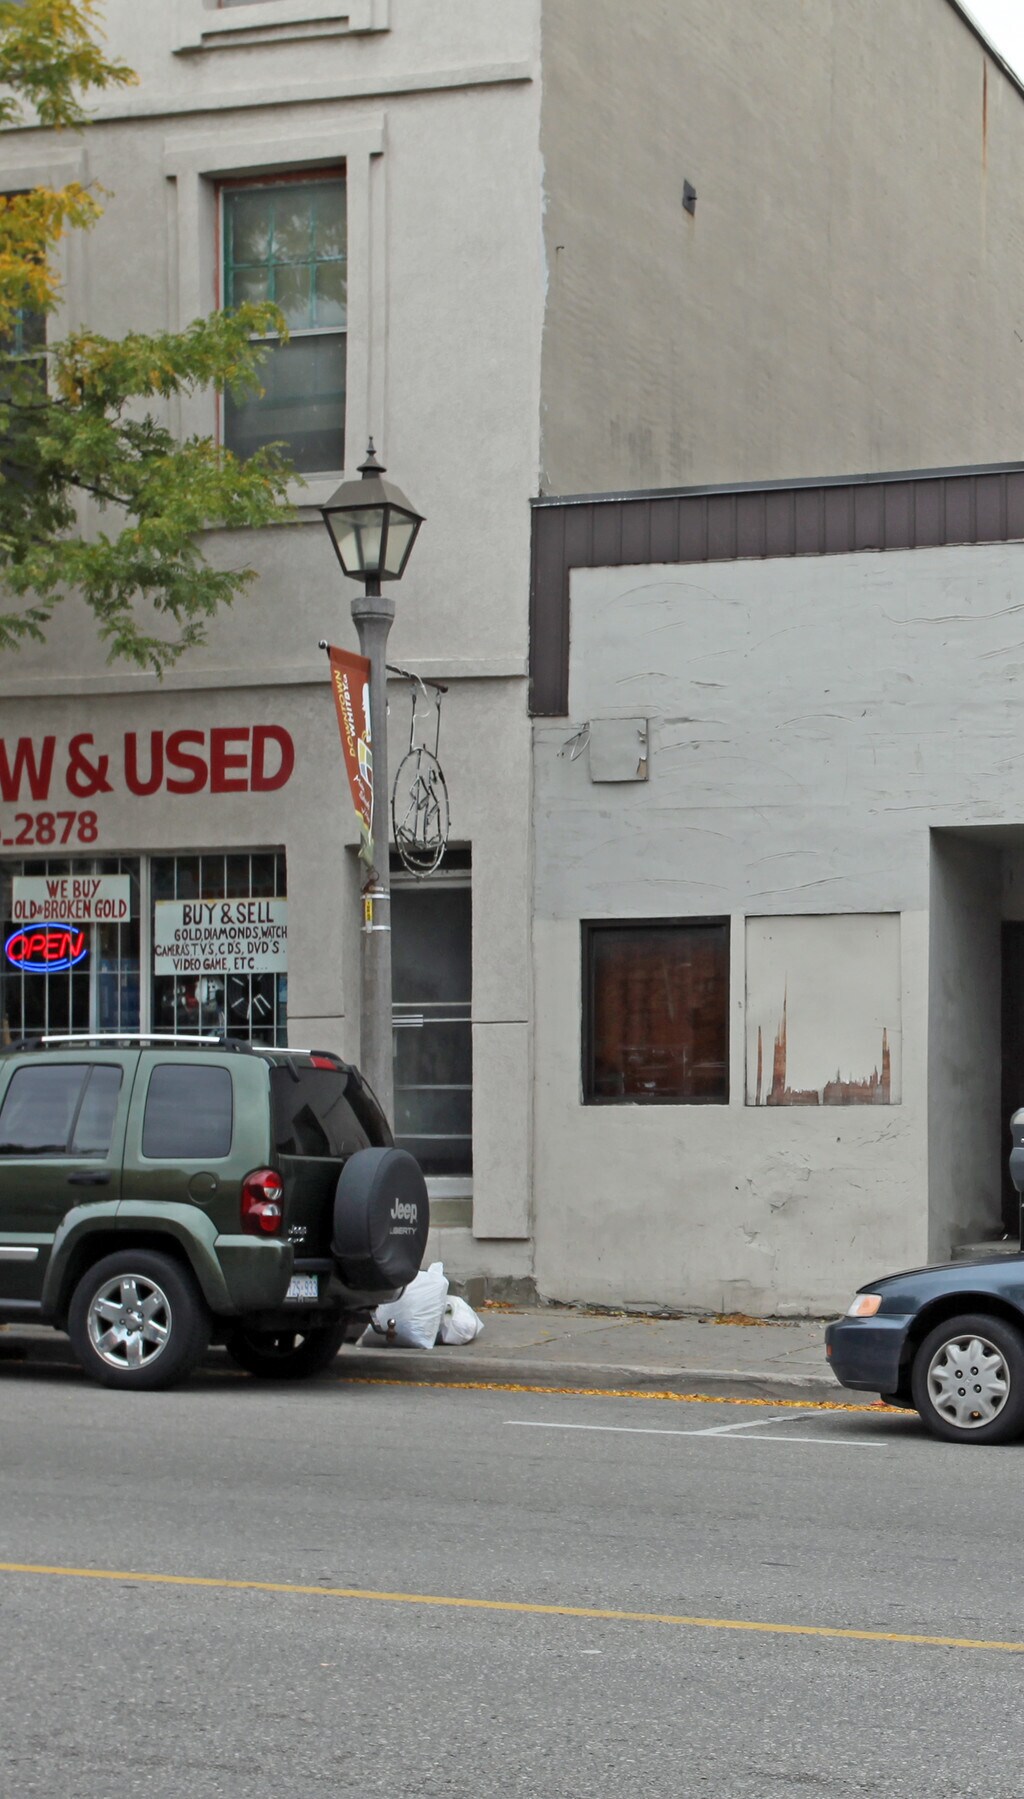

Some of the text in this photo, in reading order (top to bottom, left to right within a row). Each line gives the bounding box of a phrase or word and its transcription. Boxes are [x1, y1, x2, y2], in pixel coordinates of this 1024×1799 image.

[334, 670, 356, 757] DOWNTOWN
[65, 733, 114, 798] &
[124, 724, 295, 796] USED
[46, 879, 101, 898] WE BUY
[14, 900, 37, 919] OLD
[44, 900, 91, 919] BROKEN
[95, 899, 127, 918] GOLD
[183, 902, 274, 925] BUY & SELL
[261, 925, 288, 939] WATCH
[8, 932, 84, 960] OPEN
[172, 958, 201, 971] VIDEO
[390, 1197, 418, 1224] Jeep
[389, 1226, 418, 1235] LIBERTY
